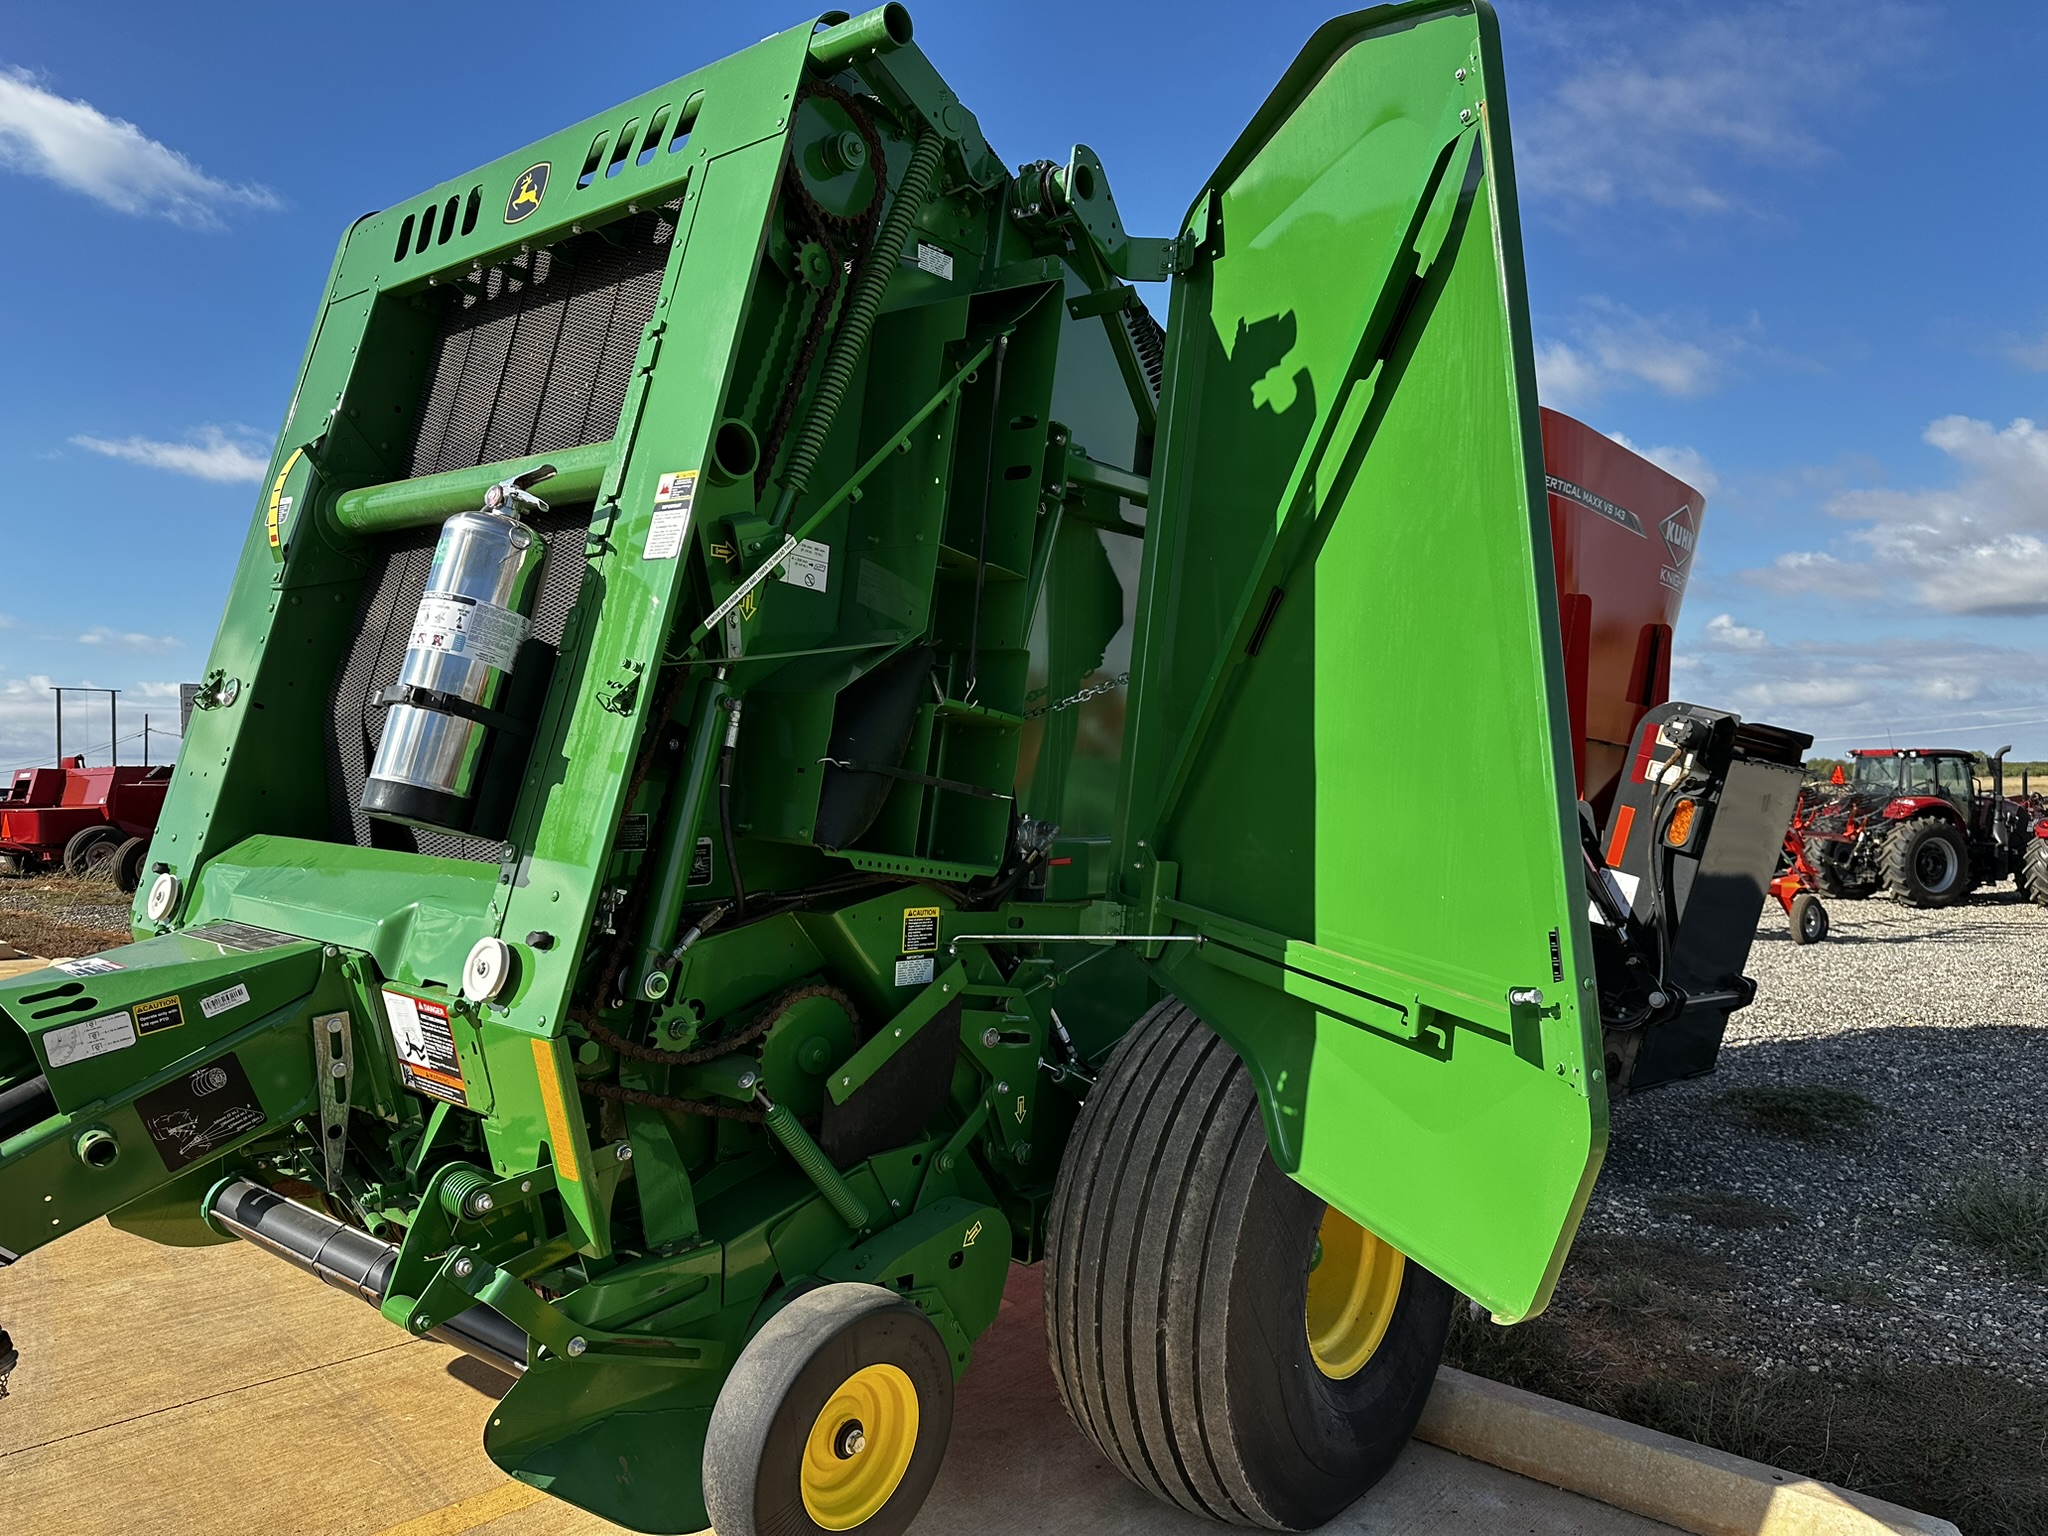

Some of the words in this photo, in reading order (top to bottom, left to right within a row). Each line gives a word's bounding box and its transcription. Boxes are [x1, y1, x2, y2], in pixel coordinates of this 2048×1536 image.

[1545, 475, 1581, 499] ERTICAL
[1582, 491, 1602, 510] MAXX
[1603, 501, 1614, 515] VS
[1614, 507, 1626, 521] 143
[1665, 519, 1694, 553] KUHN
[705, 610, 722, 627] REMOVE
[719, 603, 730, 613] ARM
[727, 593, 739, 606] FROM
[737, 583, 750, 596] NOTCH
[748, 576, 757, 585] AND
[913, 909, 937, 917] CAUTION
[142, 998, 178, 1012] CAUTION
[423, 1003, 445, 1016] DANGER
[139, 1013, 158, 1022] Operate
